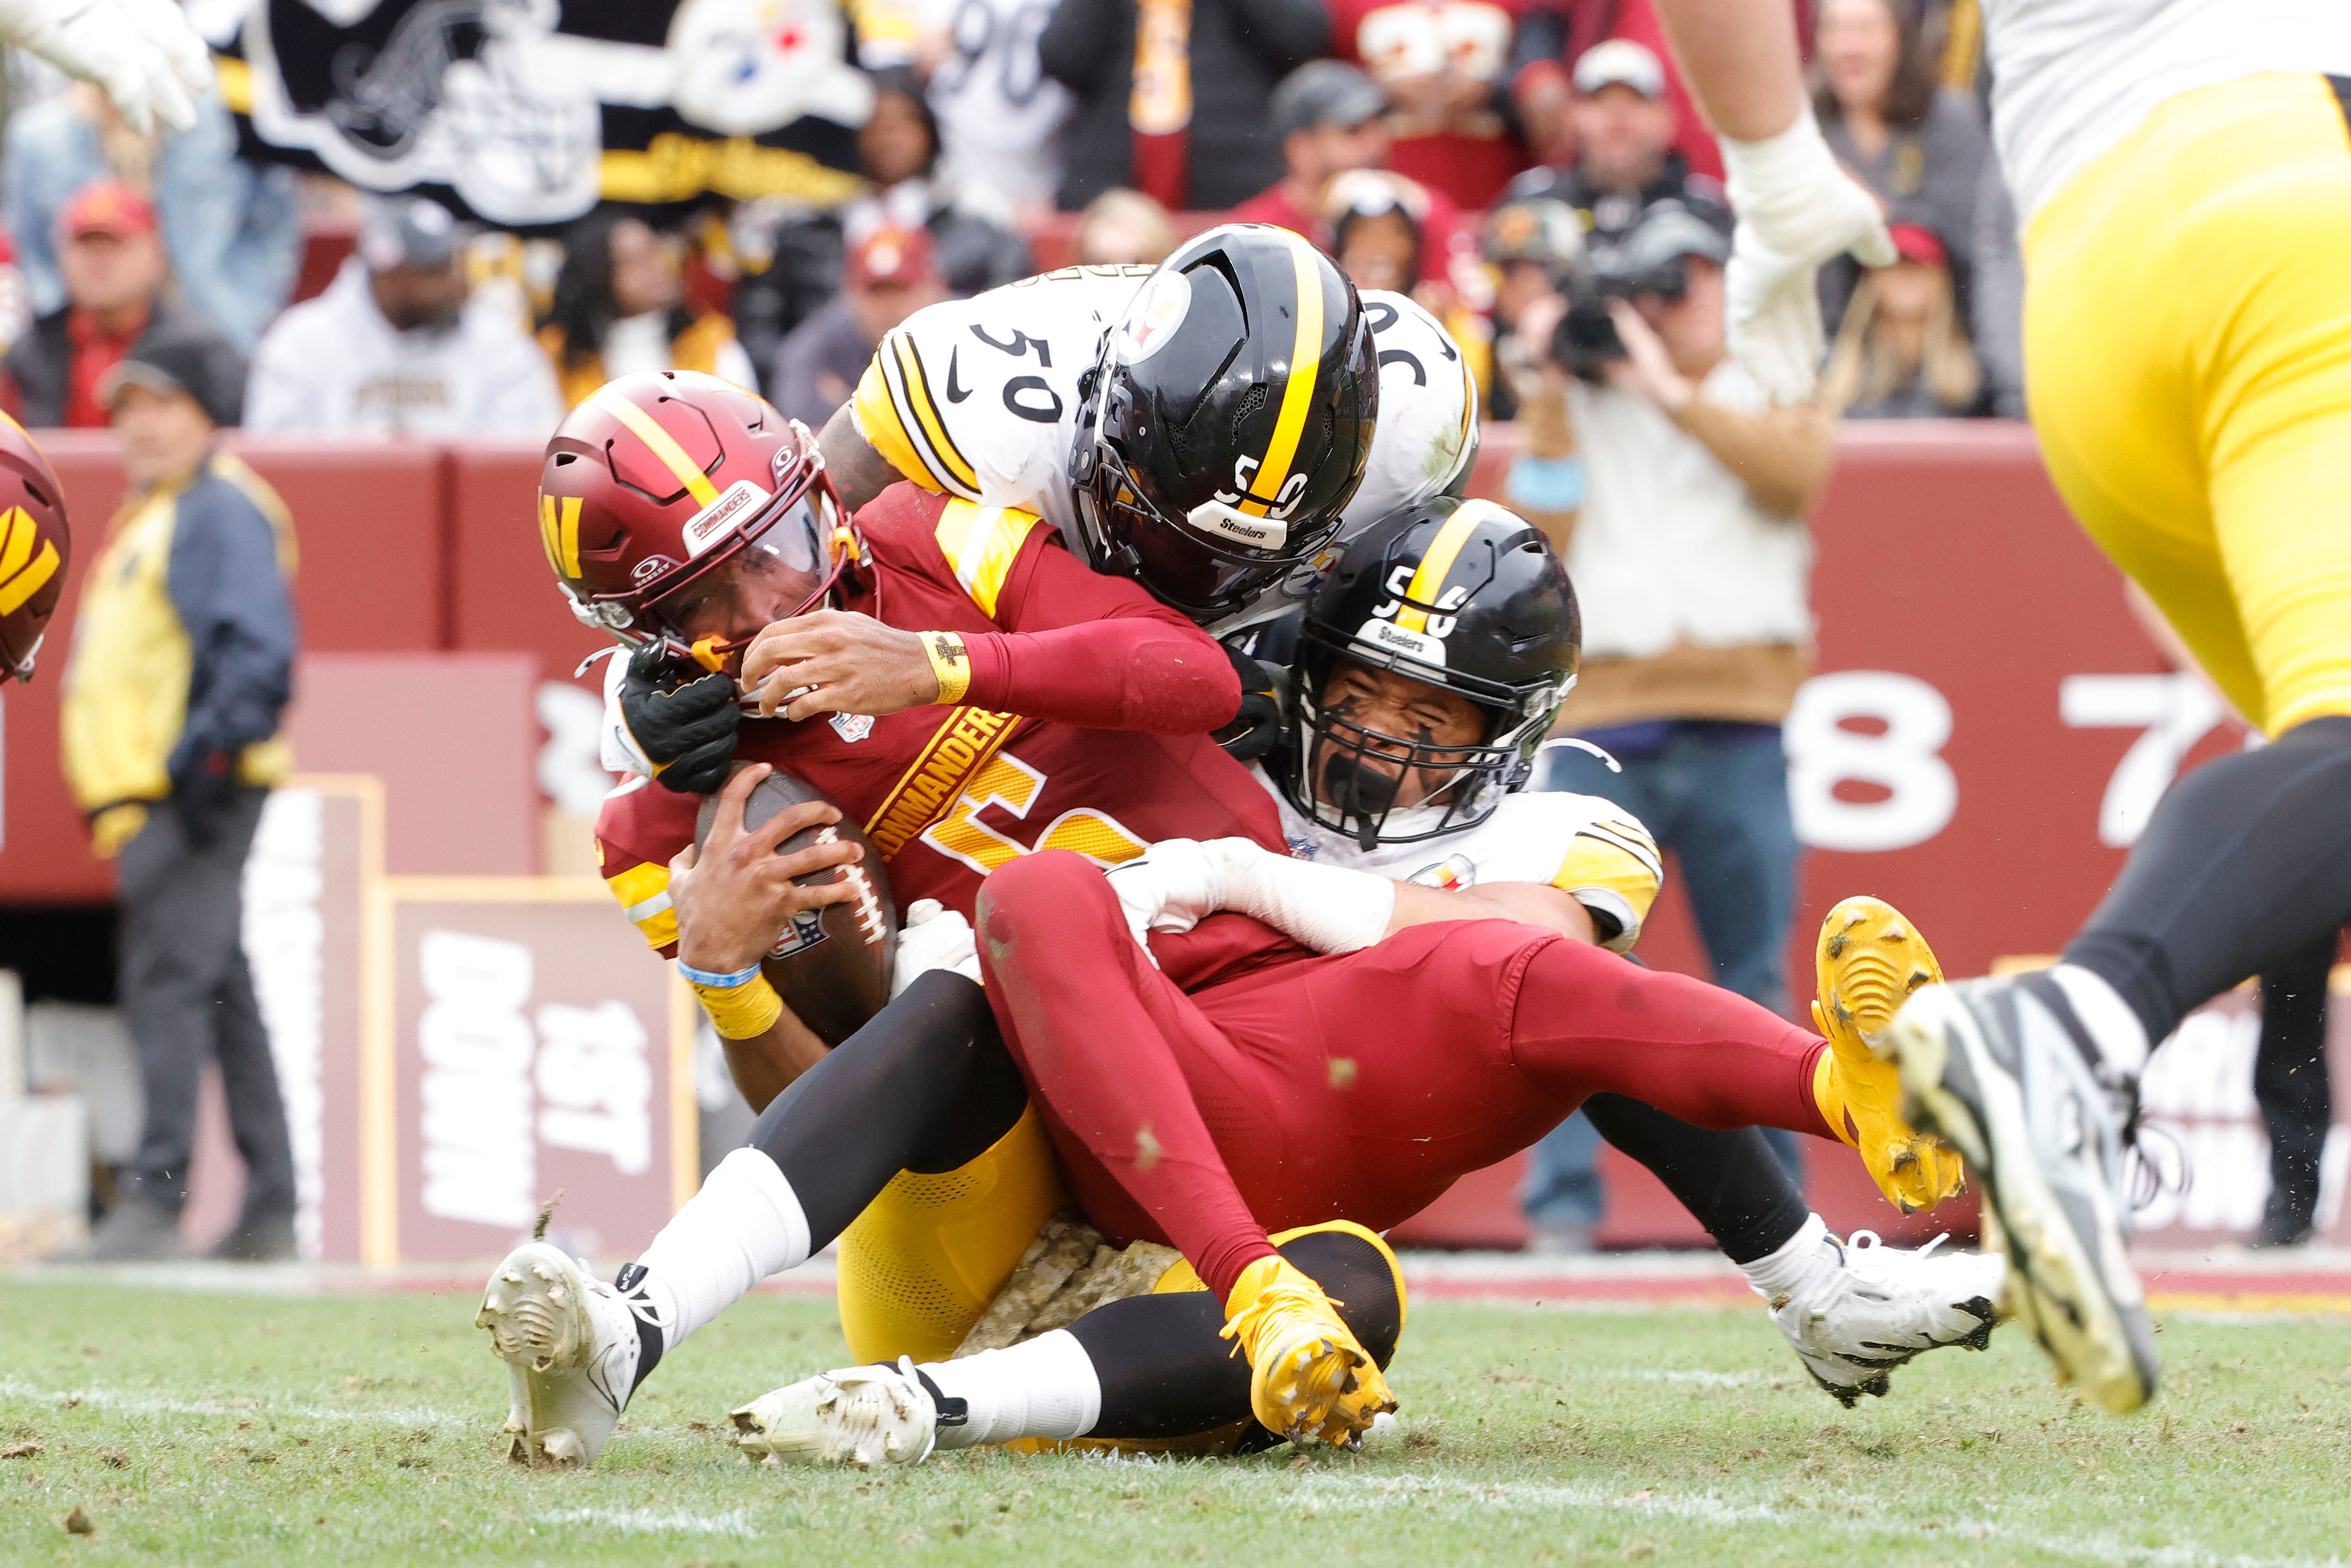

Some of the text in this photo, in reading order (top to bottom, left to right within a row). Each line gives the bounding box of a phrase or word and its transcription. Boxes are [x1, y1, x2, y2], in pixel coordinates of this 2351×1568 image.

[969, 324, 1063, 423] 50
[694, 489, 750, 537] COMMANDERS
[1214, 454, 1308, 519] 50
[1220, 518, 1267, 539] Steelers
[1371, 566, 1467, 638] 56
[1379, 626, 1425, 653] Steelers
[871, 706, 1012, 862] OMMANDER
[419, 929, 536, 1227] DOWN
[537, 1001, 653, 1176] 1ST
